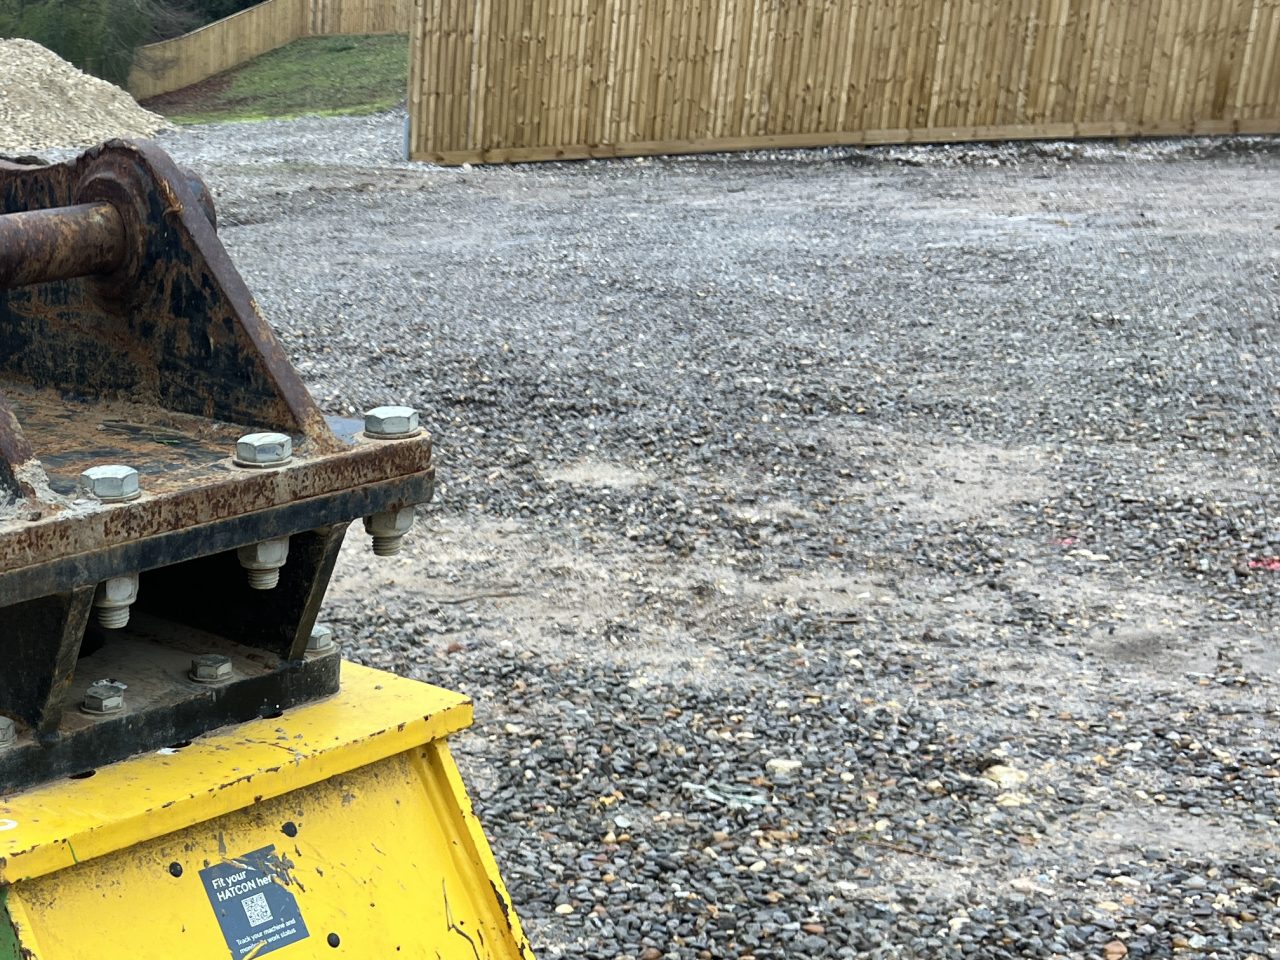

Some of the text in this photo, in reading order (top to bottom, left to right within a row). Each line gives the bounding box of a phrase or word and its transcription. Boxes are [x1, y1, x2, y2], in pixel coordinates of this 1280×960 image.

[212, 871, 246, 889] Fit your
[217, 873, 276, 901] HATCON her
